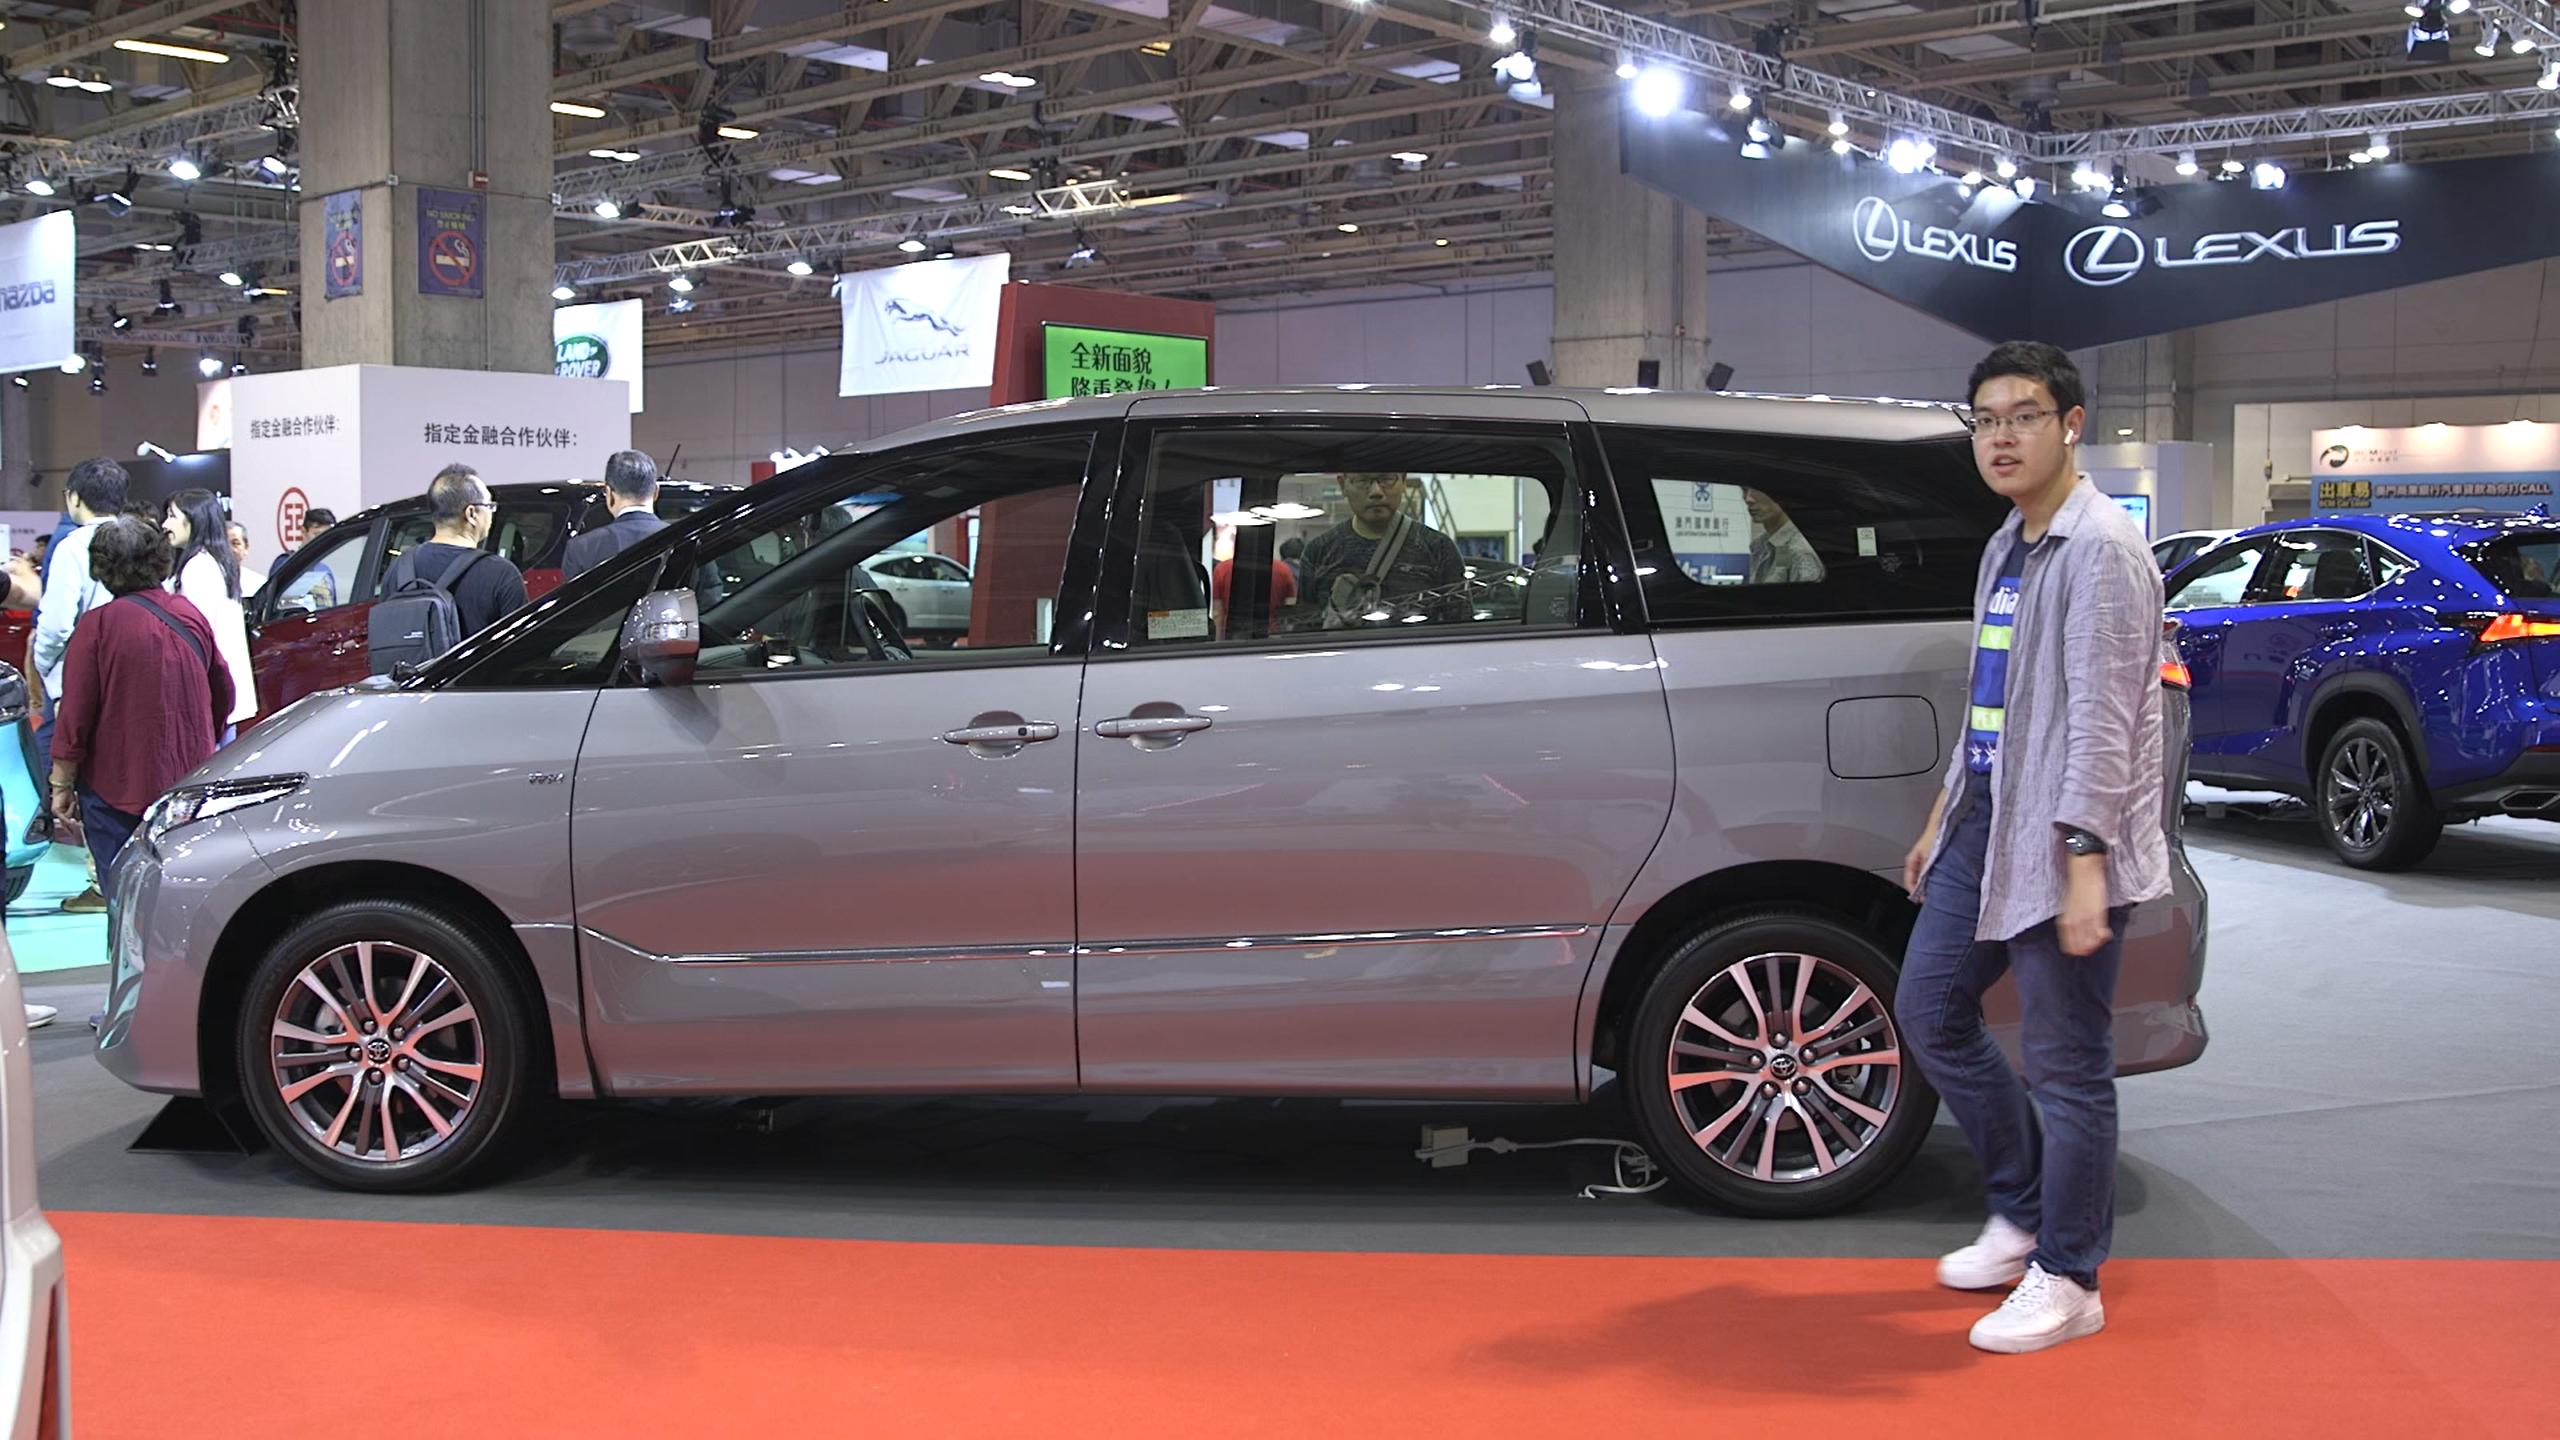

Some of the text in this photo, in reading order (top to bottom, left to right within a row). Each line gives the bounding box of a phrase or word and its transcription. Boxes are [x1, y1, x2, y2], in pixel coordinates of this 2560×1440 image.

[1902, 220, 2017, 272] LEXUS
[2153, 219, 2402, 269] LEXUS
[556, 342, 590, 362] LAND
[874, 344, 970, 365] JAGUAR
[1071, 342, 1153, 375] 全新面貌
[560, 359, 602, 378] ROVER
